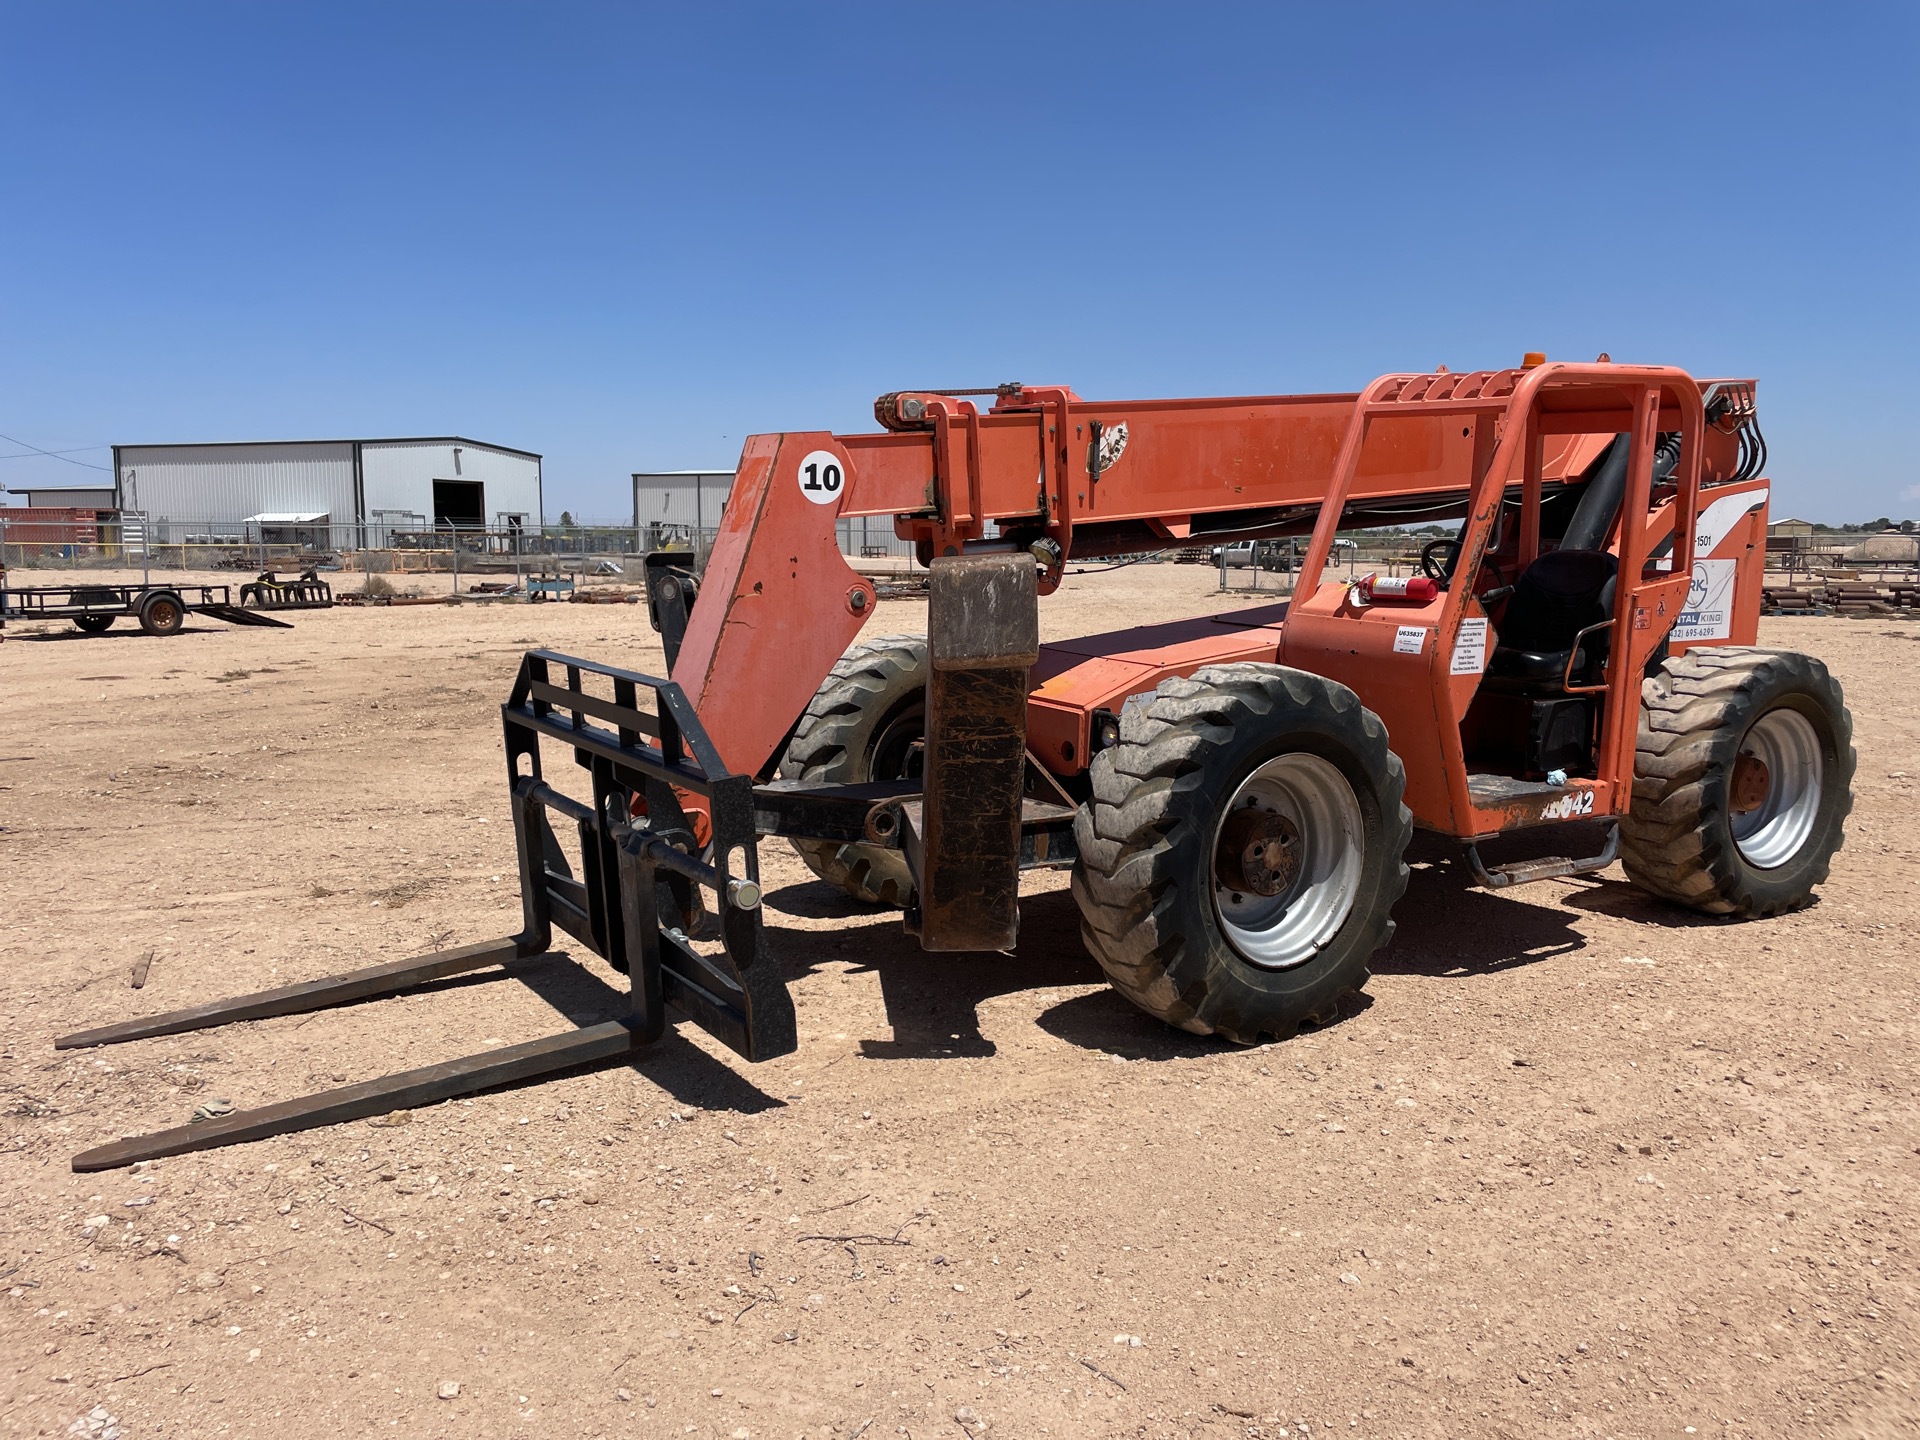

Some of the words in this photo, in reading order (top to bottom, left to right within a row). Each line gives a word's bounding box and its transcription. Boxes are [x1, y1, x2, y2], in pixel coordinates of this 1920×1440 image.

[804, 463, 841, 492] 10
[1694, 535, 1711, 546] -1501
[1677, 615, 1697, 623] NTAL
[1701, 614, 1721, 622] KING
[1670, 630, 1684, 638] 432)
[1686, 628, 1714, 637] 695-6295
